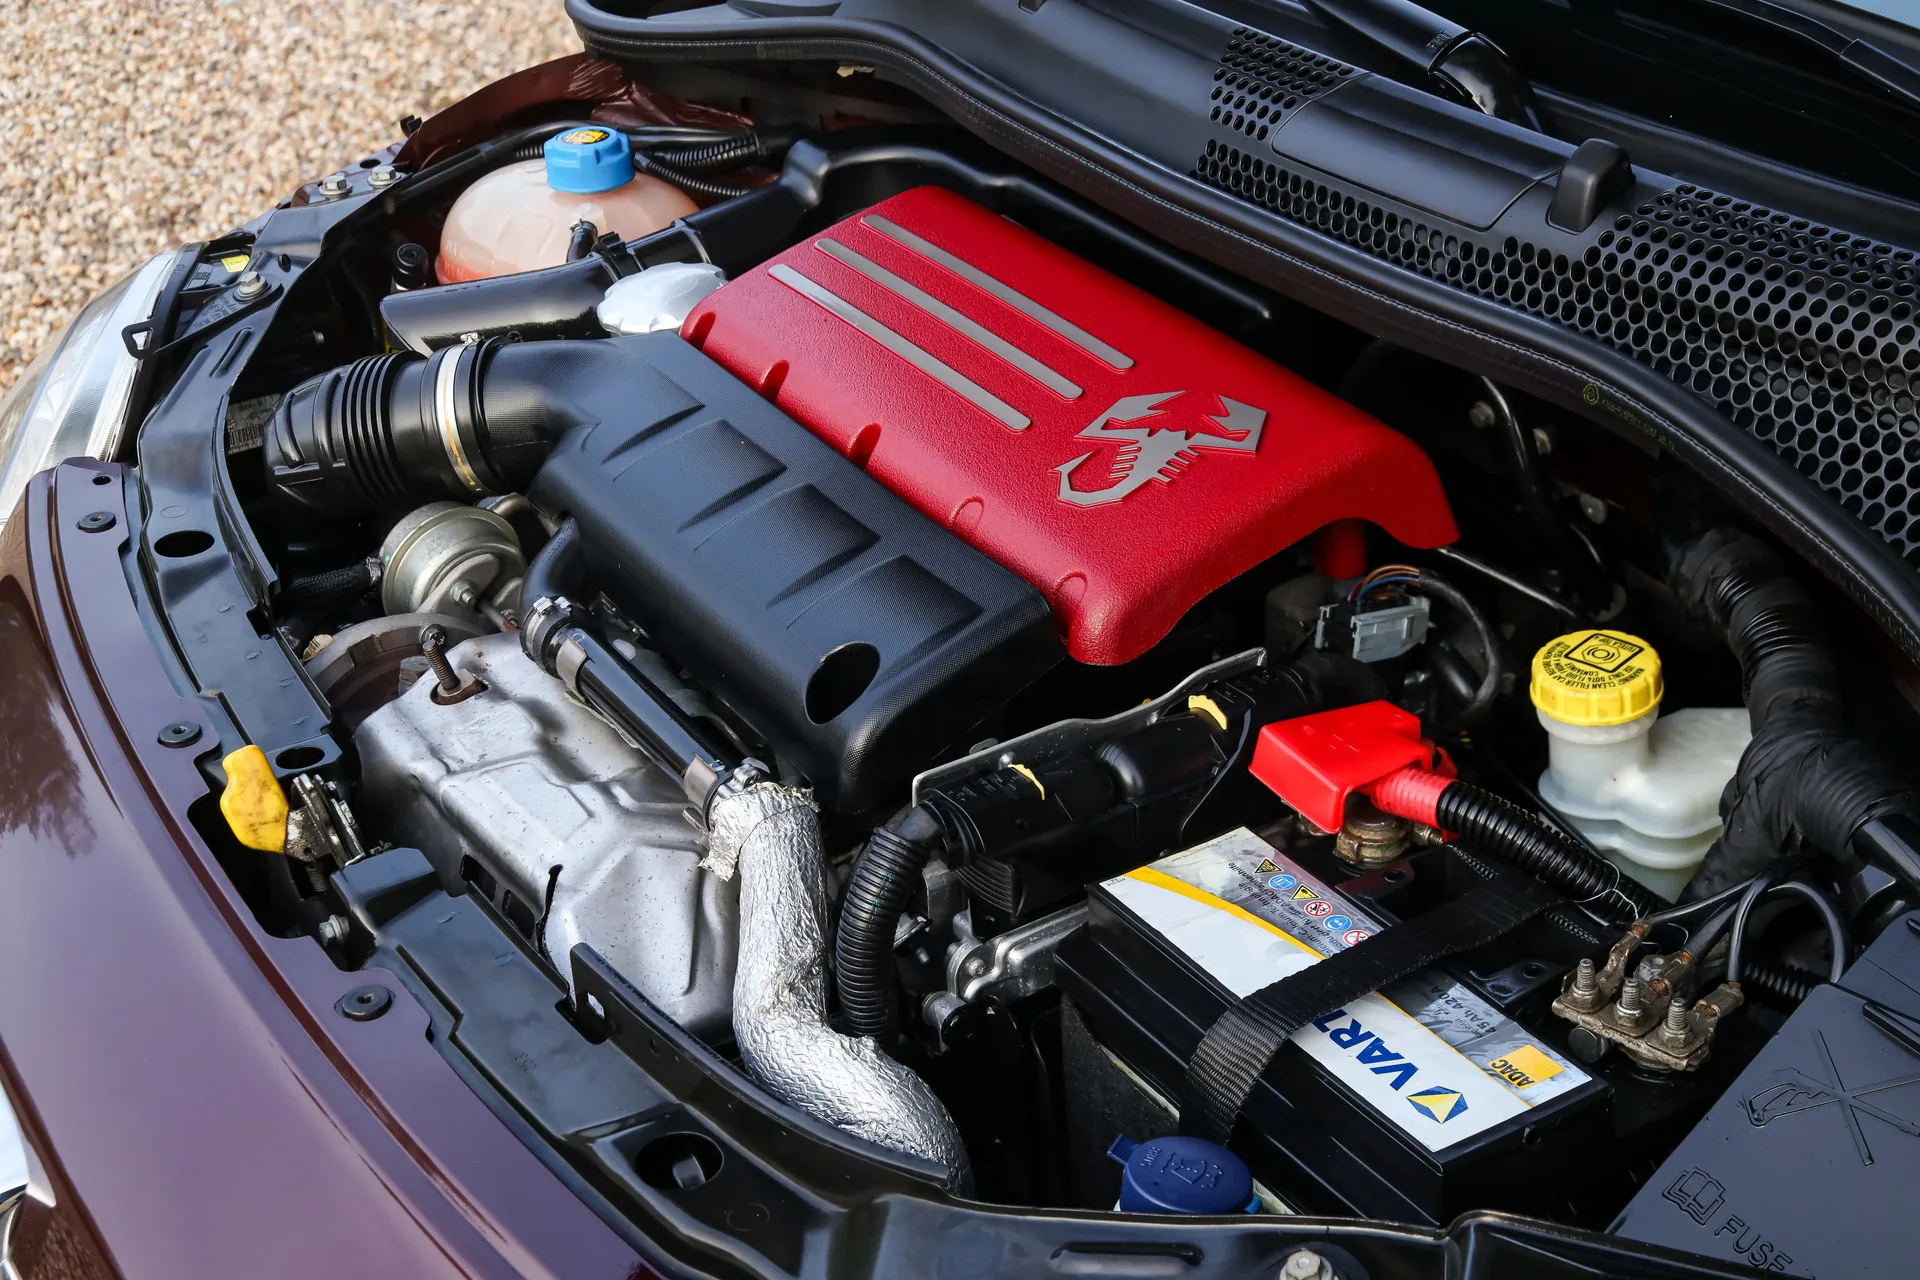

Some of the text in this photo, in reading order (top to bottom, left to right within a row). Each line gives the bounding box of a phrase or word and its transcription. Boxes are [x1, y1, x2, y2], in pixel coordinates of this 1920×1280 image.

[1613, 641, 1637, 653] TUTELA
[1552, 674, 1567, 682] CAP
[1565, 672, 1588, 682] FLUID
[1608, 671, 1625, 680] ONLY
[1565, 680, 1590, 690] FILLER
[1592, 681, 1616, 690] CLEAN
[1266, 890, 1288, 908] ADAC
[1279, 911, 1334, 958] alcium-Calcium
[1309, 922, 1346, 950] roduziert
[1431, 986, 1464, 1010] 420A
[1312, 1009, 1419, 1092] VART
[1491, 1059, 1535, 1087] ADAC
[1714, 1214, 1794, 1271] FUSE
